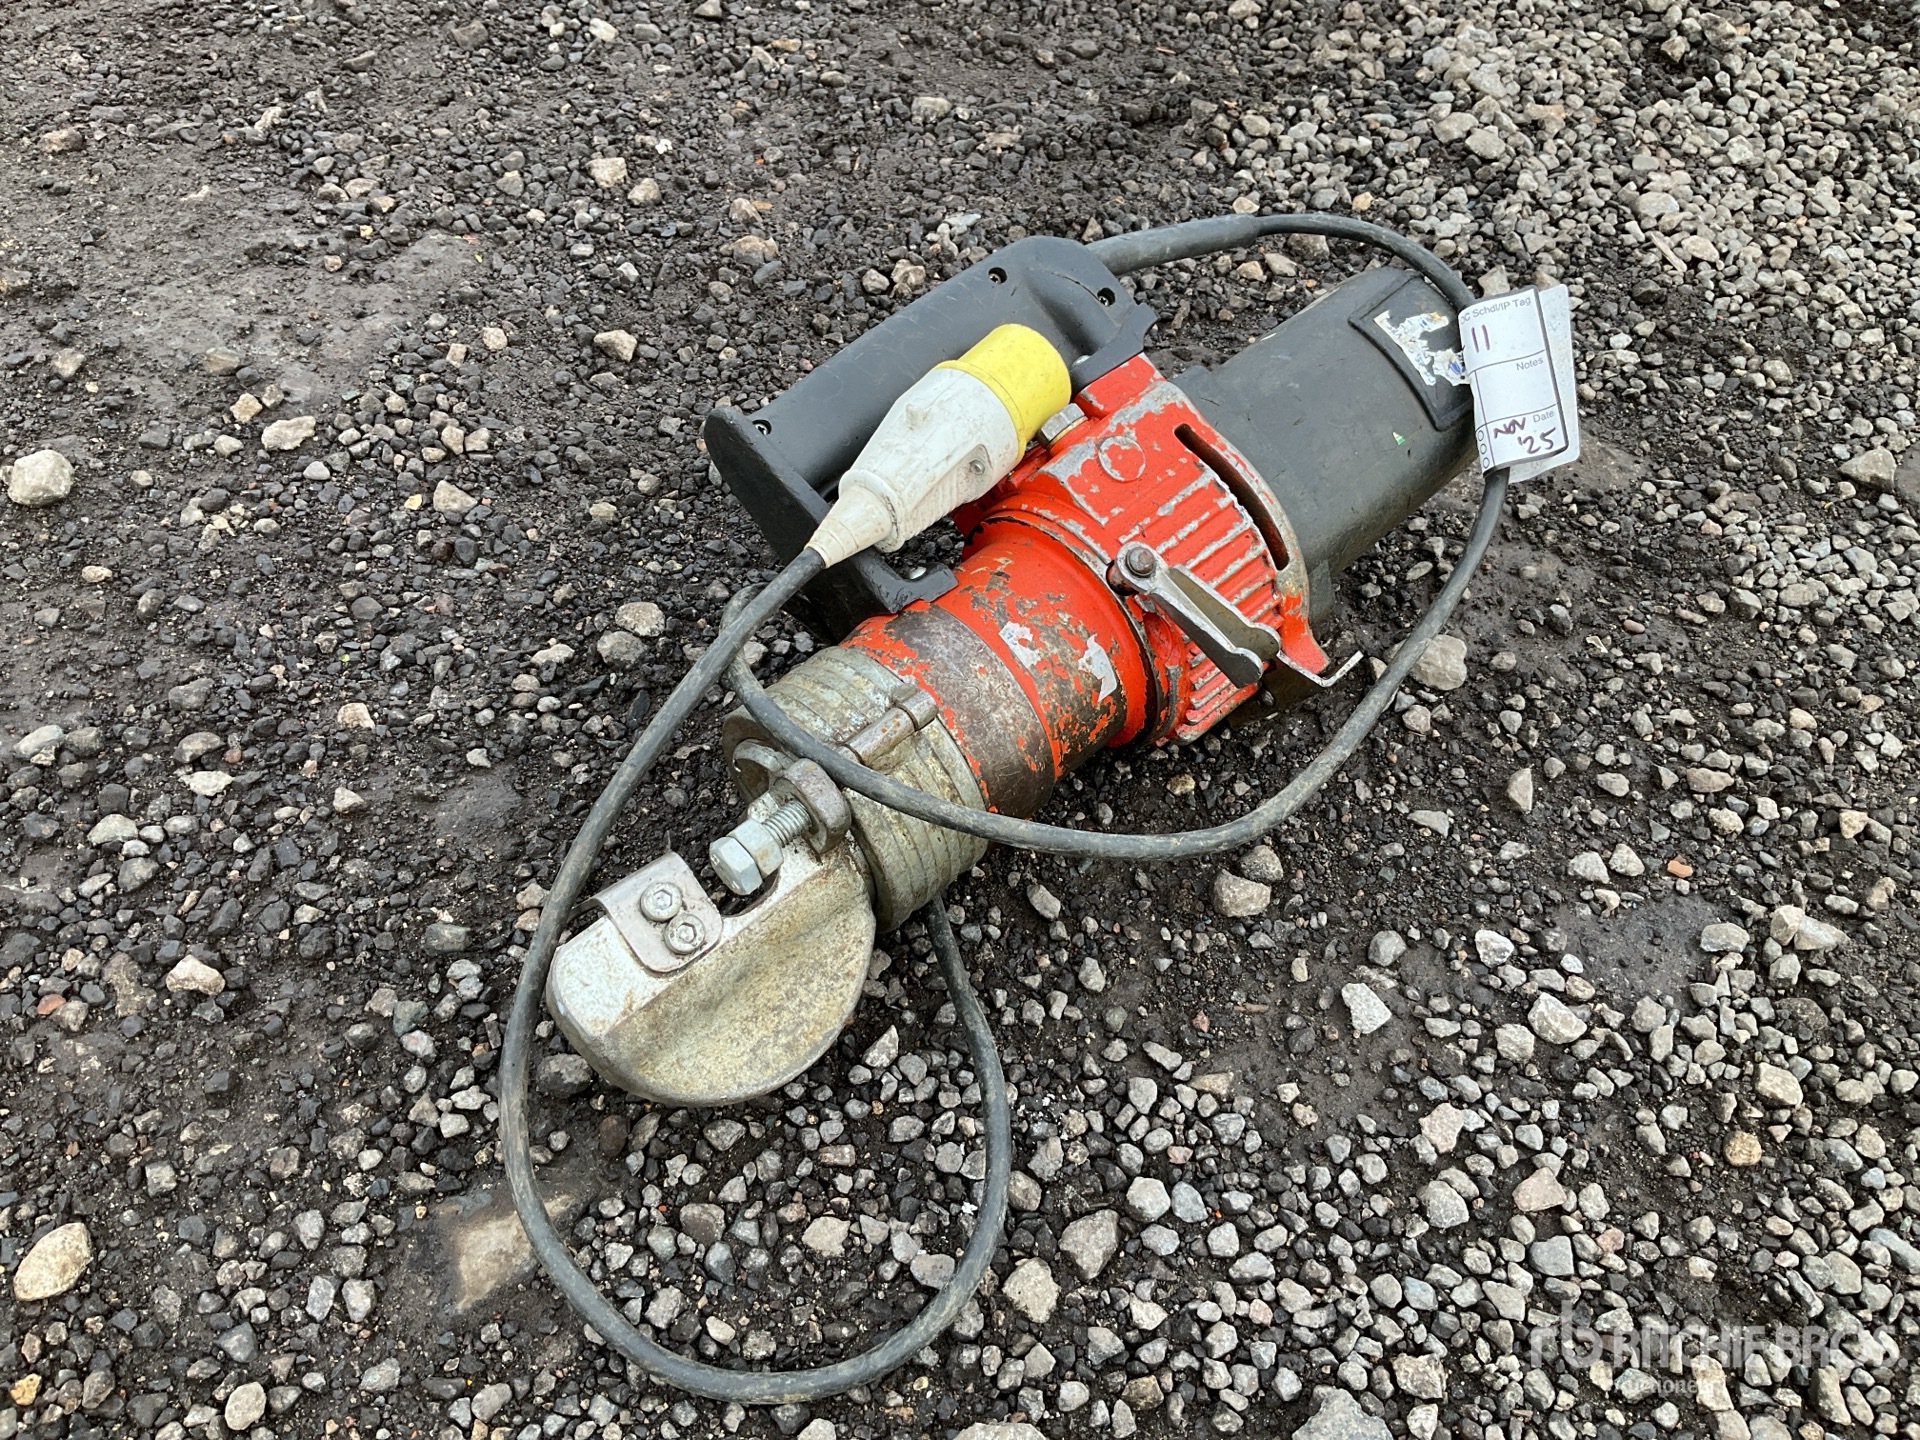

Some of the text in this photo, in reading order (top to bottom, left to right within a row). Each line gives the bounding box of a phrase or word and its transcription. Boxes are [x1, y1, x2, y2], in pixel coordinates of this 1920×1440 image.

[1512, 297, 1532, 309] Tag
[1516, 357, 1544, 371] Notes
[1533, 410, 1555, 423] Date
